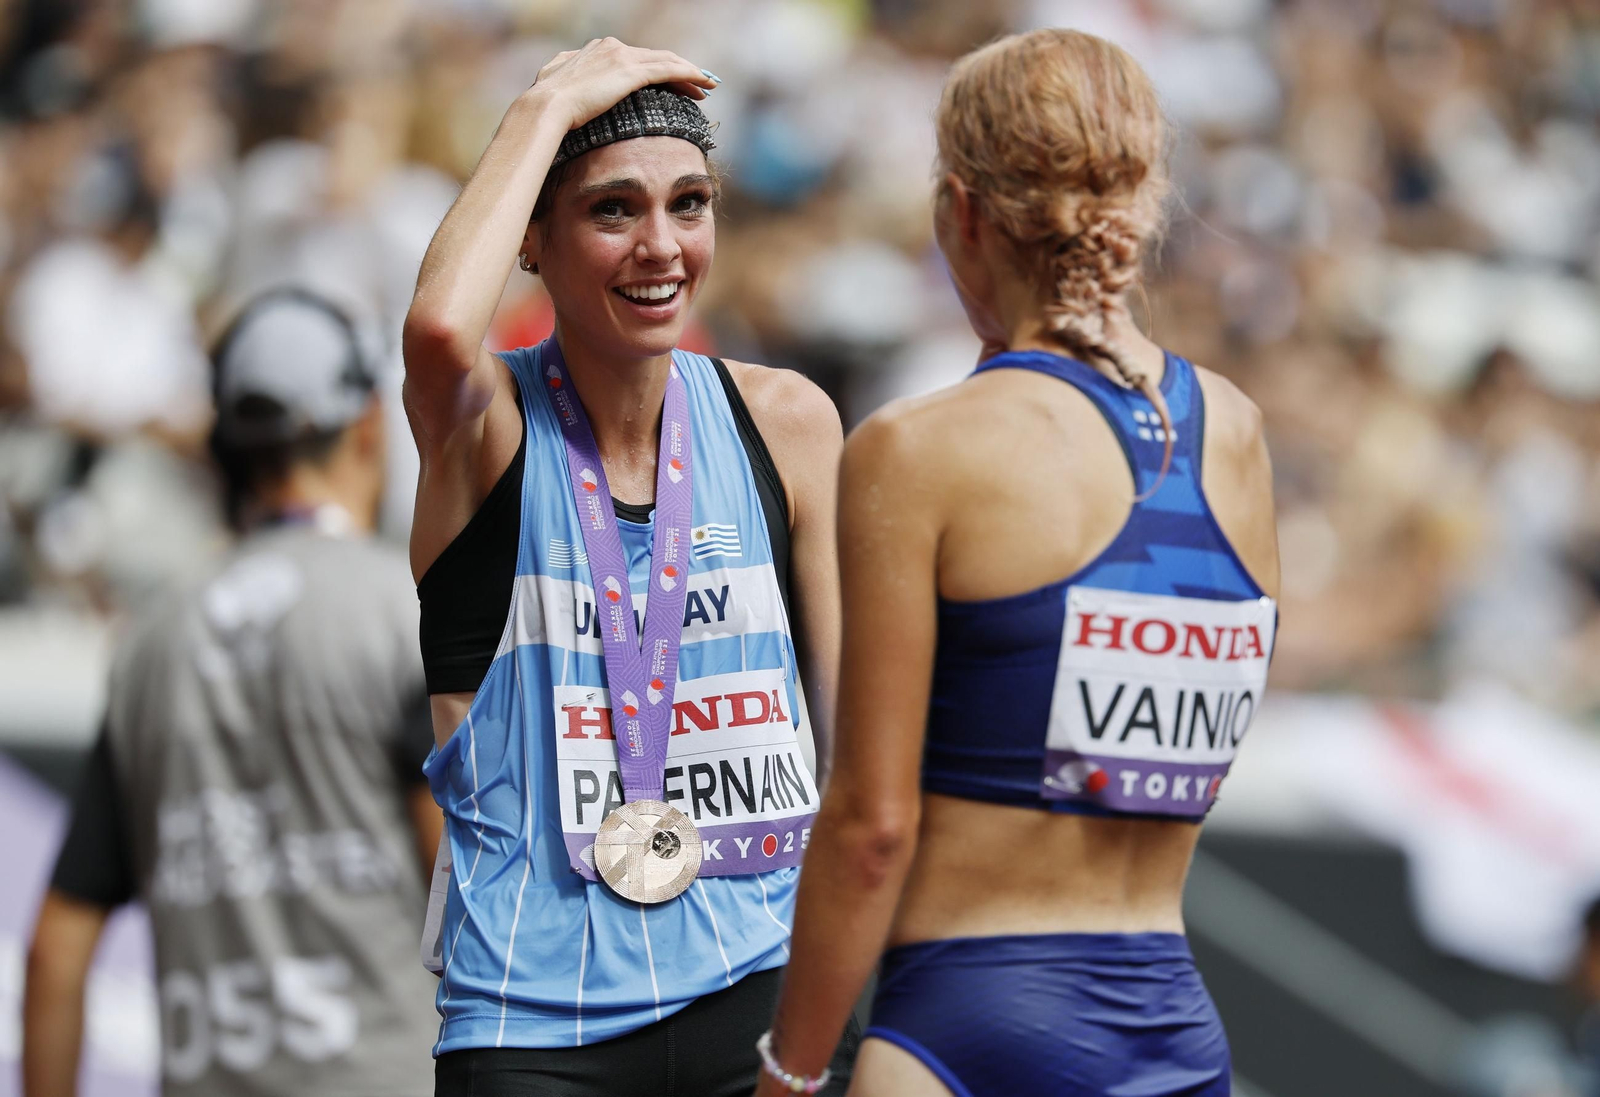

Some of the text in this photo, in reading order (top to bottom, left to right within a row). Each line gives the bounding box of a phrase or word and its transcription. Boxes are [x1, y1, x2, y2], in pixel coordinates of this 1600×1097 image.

[1073, 612, 1266, 661] HONDA
[561, 689, 788, 741] HNDA
[1078, 679, 1254, 750] VAINIO
[573, 752, 811, 825] PAERNAIN
